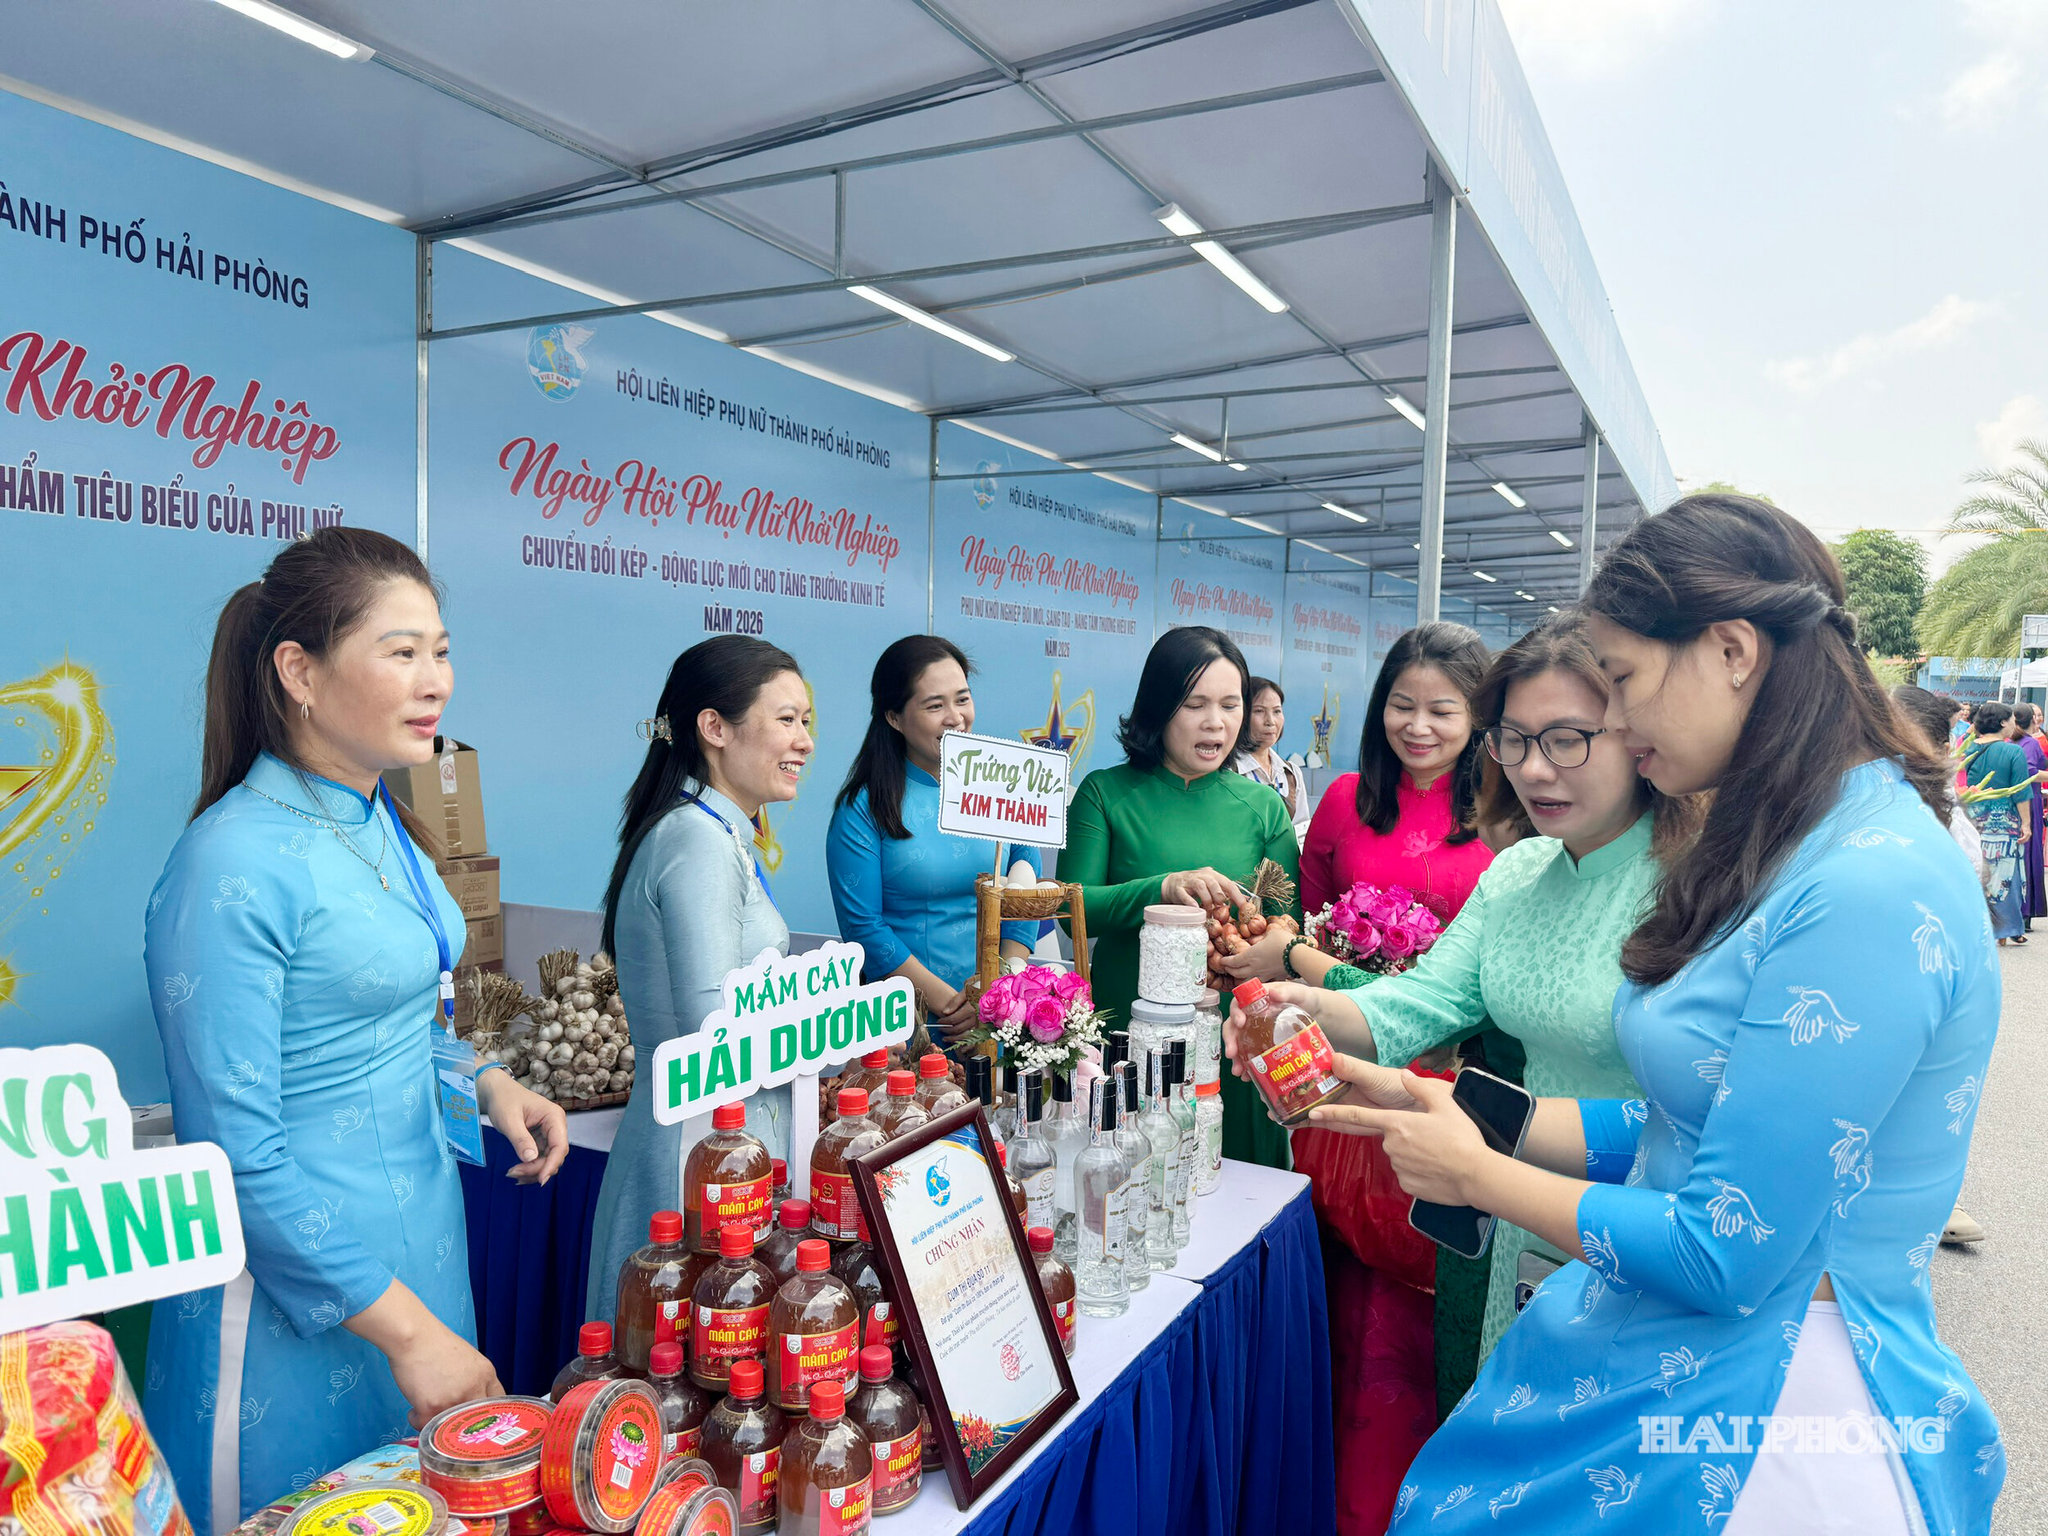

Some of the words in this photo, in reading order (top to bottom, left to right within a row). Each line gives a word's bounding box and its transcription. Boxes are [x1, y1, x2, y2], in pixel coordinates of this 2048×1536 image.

[80, 215, 147, 264] PHỐ
[156, 232, 204, 281] HẢI
[213, 256, 309, 310] PHÒNG
[0, 331, 151, 427] Khởi
[147, 363, 342, 486] Nghiệp
[617, 368, 642, 401] HỘI
[647, 377, 679, 407] LIÊN
[684, 388, 715, 420] HIỆP
[719, 400, 745, 431] PHỤ
[749, 407, 767, 433] NỮ
[769, 414, 808, 445] THÀNH
[812, 426, 833, 452] PHỐ
[836, 431, 853, 458] HẢI
[856, 441, 890, 469] PHÒNG
[0, 450, 64, 515] HẨM
[73, 470, 132, 523] TIÊU
[142, 473, 199, 530] BIỂU
[207, 483, 254, 537] CỦA
[498, 436, 615, 527] Ngày
[614, 459, 678, 527] Hội
[681, 474, 741, 539] Phụ
[740, 487, 785, 538] Nữ
[784, 496, 834, 545] Khởi
[833, 507, 900, 574] Nghiệp
[1009, 485, 1021, 508] HỘI
[1022, 489, 1038, 510] LIÊN
[1038, 494, 1053, 516] HIỆP
[522, 529, 586, 572] CHUYỂN
[590, 535, 616, 575] ĐỔI
[620, 544, 648, 578] KÉP
[661, 551, 698, 588] ĐỘNG
[701, 559, 725, 592] LỰC
[728, 561, 751, 590] MỚI
[754, 567, 776, 594] CHO
[779, 568, 807, 598] TĂNG
[809, 570, 848, 603] TRƯỞNG
[850, 581, 873, 606] KINH
[875, 578, 886, 607] TẾ
[960, 535, 1007, 591] Ngày
[1007, 544, 1035, 588] Hội
[1036, 552, 1062, 595] Phụ
[1063, 558, 1084, 592] Nữ
[1105, 566, 1139, 611] Nghiệp
[704, 603, 732, 633] NĂM
[736, 609, 763, 635] 2026
[1045, 637, 1057, 657] NĂM
[957, 749, 1021, 793] Trứng
[1023, 758, 1053, 798] Vịt
[960, 792, 992, 818] KIM
[996, 797, 1047, 827] THÀNH
[734, 964, 798, 1018] MẮM
[806, 956, 855, 996] CÁY
[668, 1027, 752, 1109] HẢI
[770, 989, 907, 1073] DƯƠNG
[925, 1234, 959, 1266] CHỨNG
[958, 1217, 985, 1241] NHẬN
